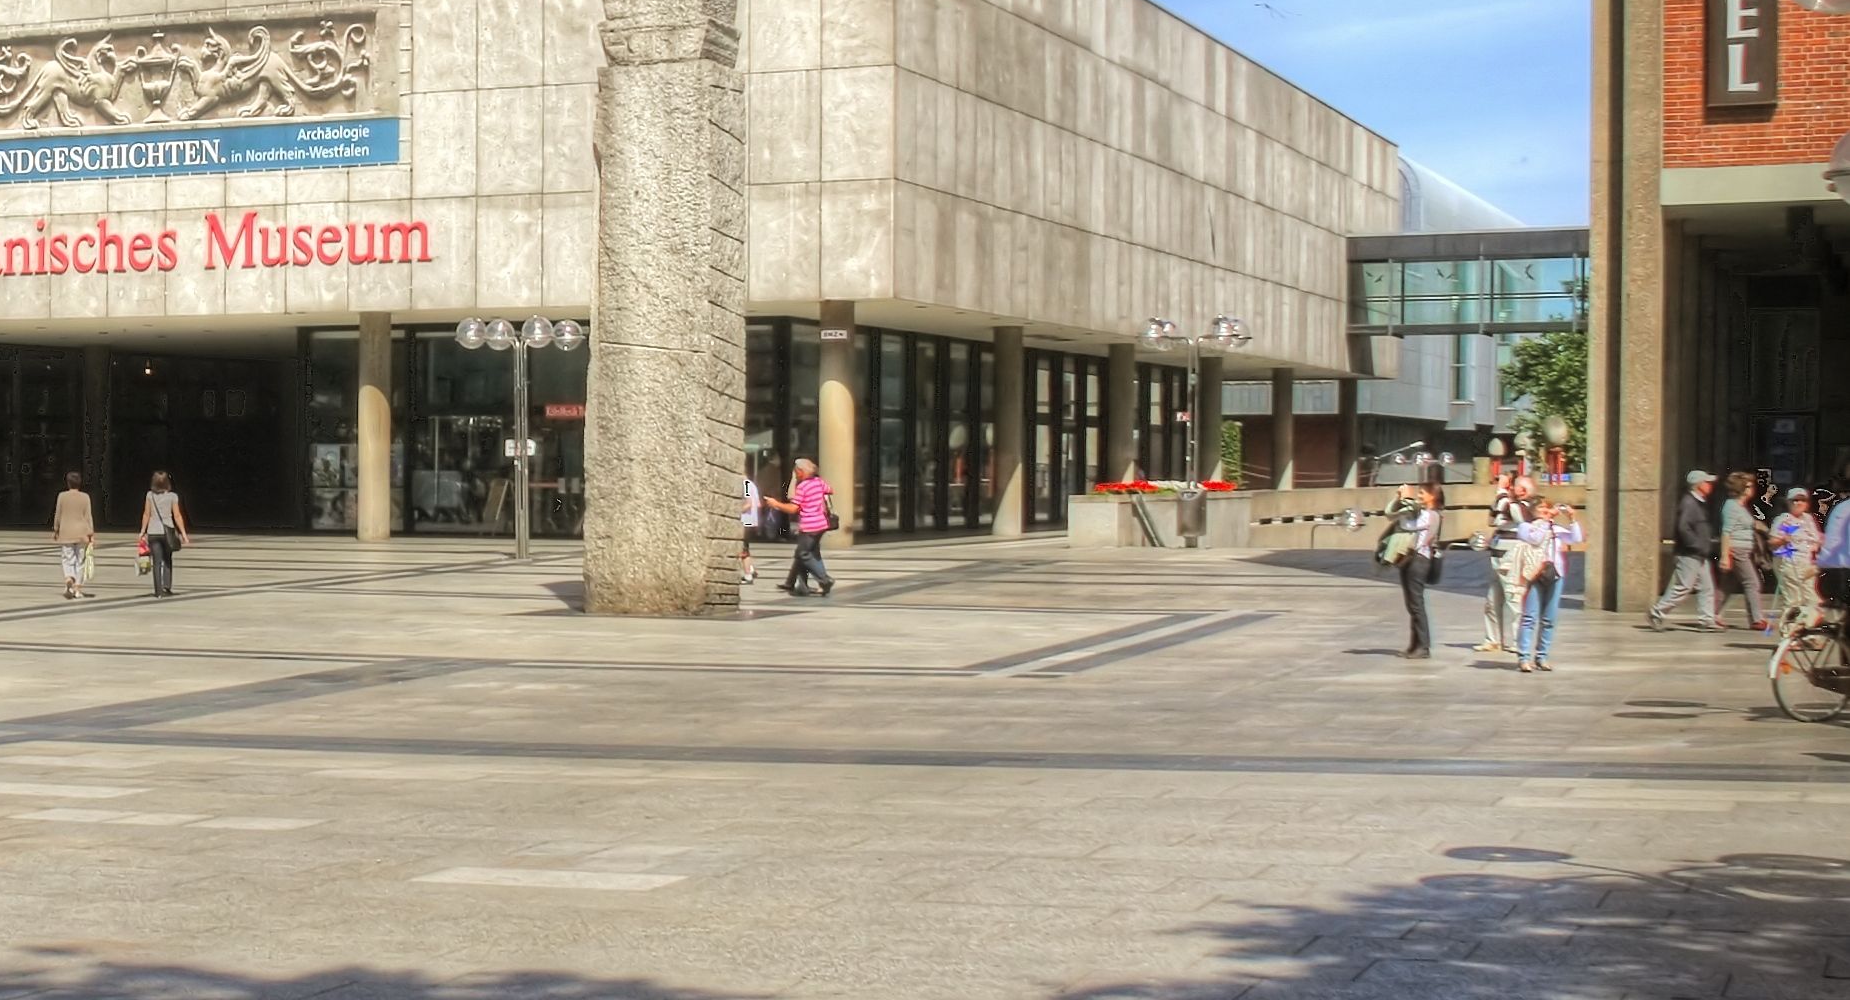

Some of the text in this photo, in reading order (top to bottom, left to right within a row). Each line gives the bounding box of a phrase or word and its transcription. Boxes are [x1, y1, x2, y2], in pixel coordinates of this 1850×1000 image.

[297, 124, 370, 142] Archäologie
[231, 143, 370, 163] in Nordrhein-Westfalen
[204, 211, 433, 270] Museum
